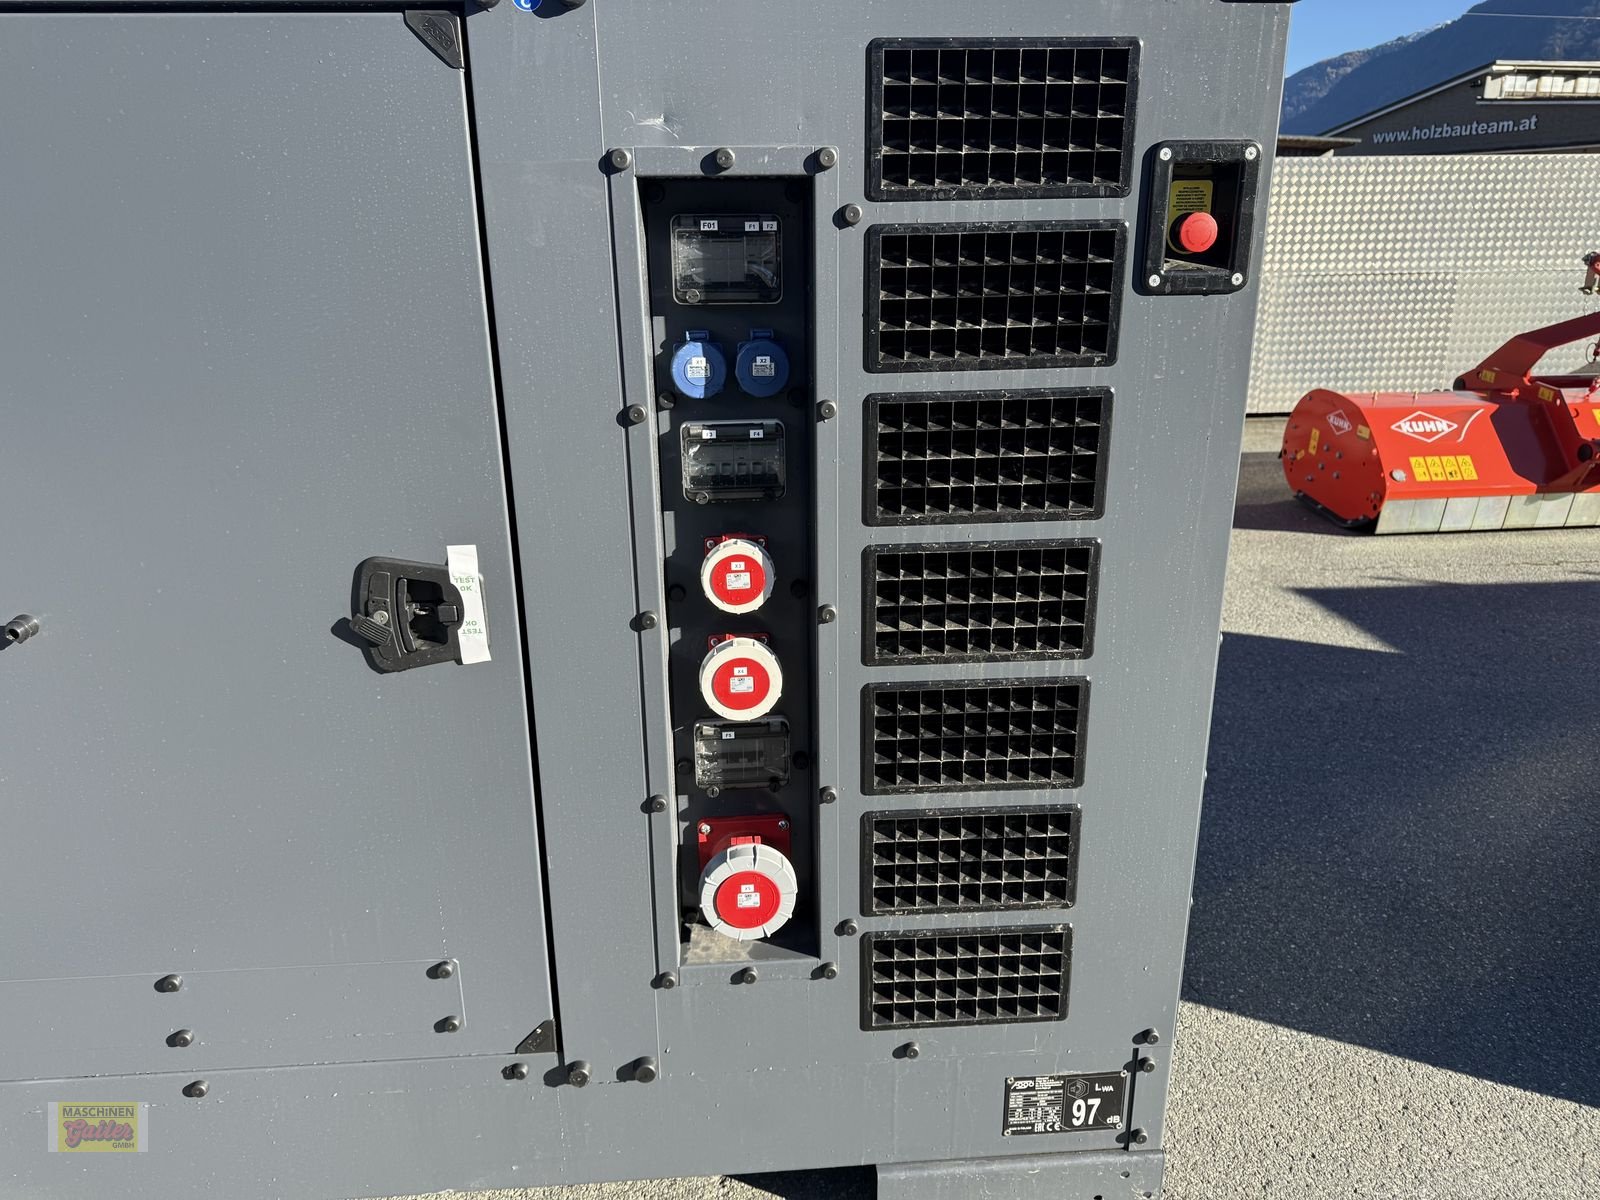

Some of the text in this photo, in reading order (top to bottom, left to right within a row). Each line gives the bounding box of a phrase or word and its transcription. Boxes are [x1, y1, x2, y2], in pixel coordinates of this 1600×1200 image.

[1373, 115, 1537, 143] www.holzbauteam.at
[1329, 415, 1349, 430] KUHN
[1400, 420, 1449, 433] KUHN
[1071, 1098, 1101, 1126] 97
[1106, 1115, 1121, 1124] dB
